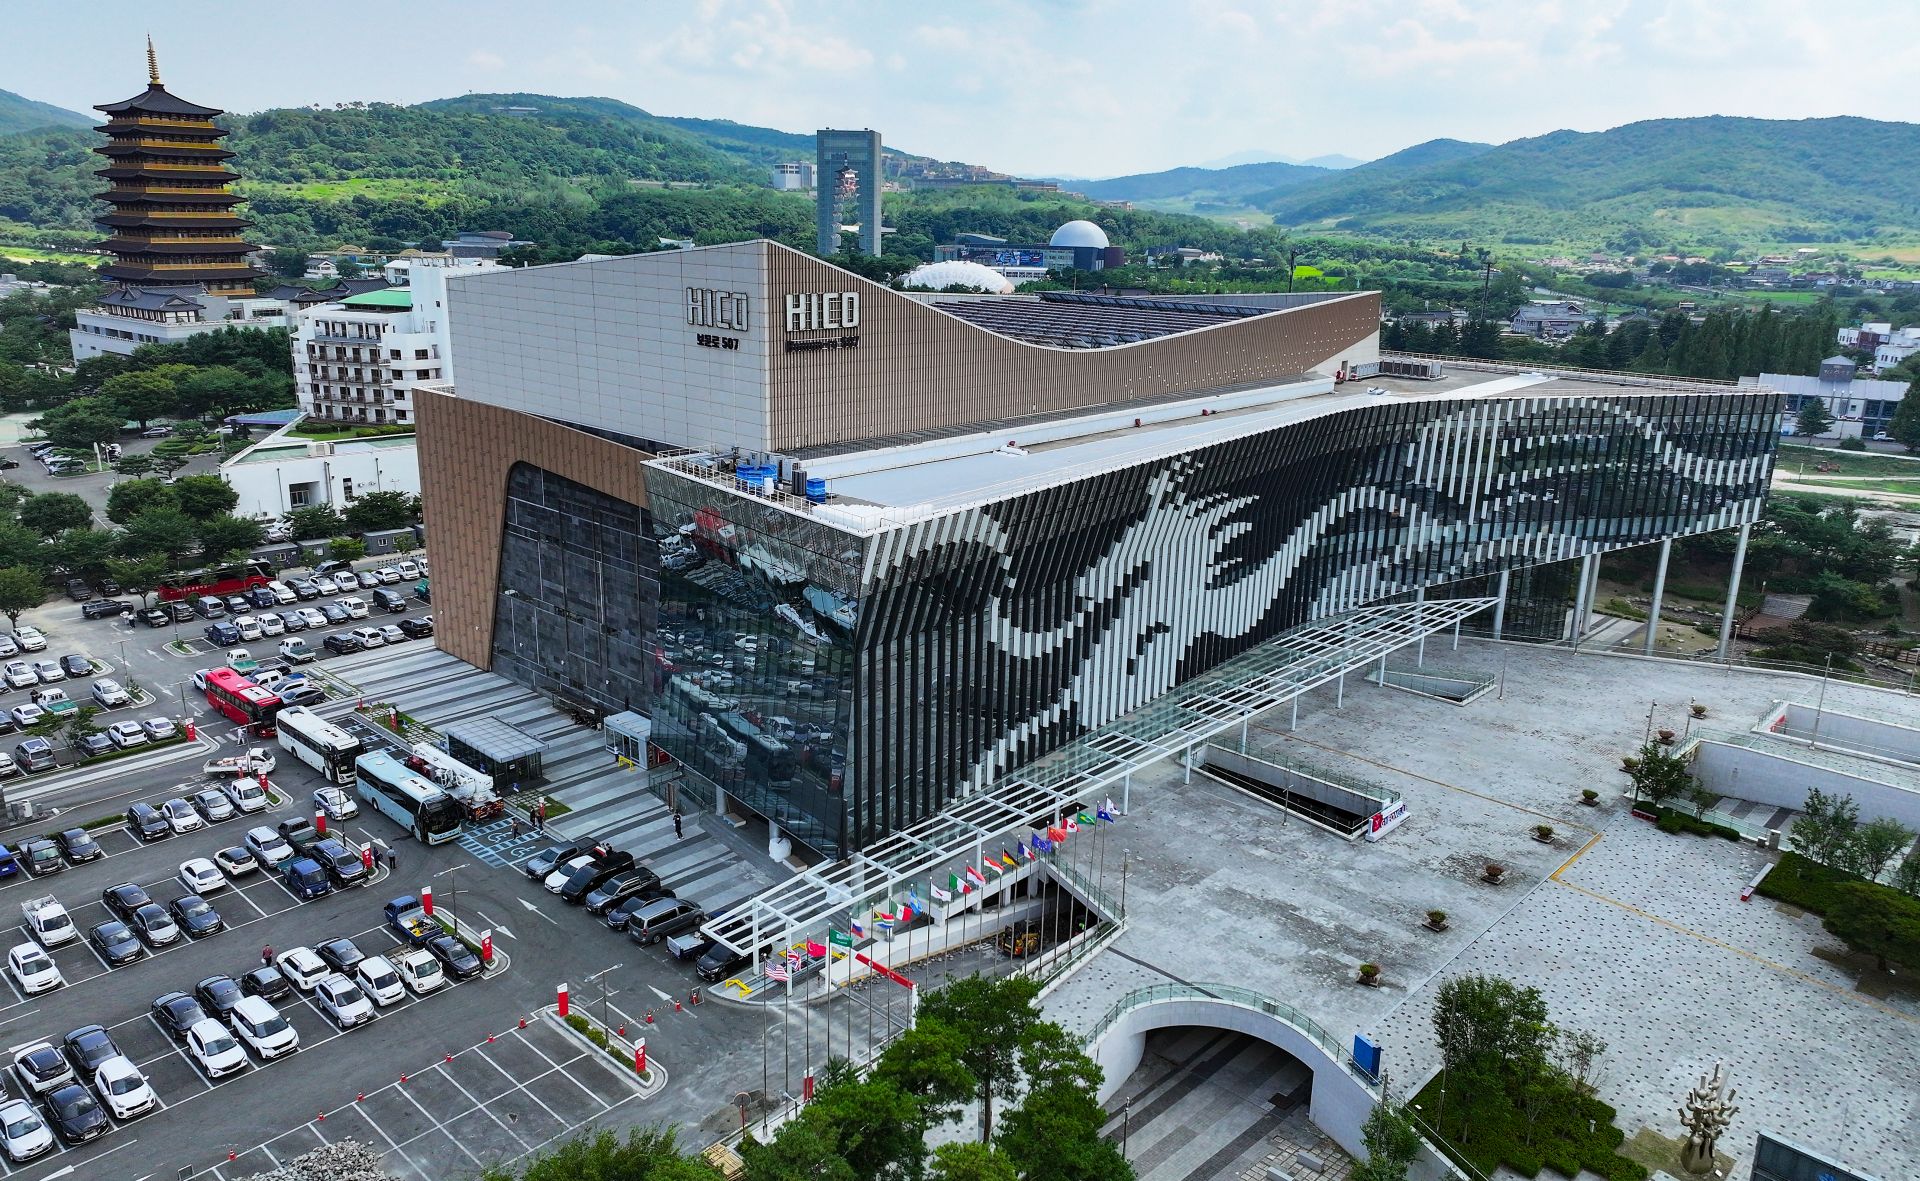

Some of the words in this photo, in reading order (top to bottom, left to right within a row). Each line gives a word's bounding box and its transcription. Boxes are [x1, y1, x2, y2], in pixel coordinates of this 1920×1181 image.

[686, 286, 749, 332] HICO
[786, 291, 860, 332] HICO
[721, 336, 740, 351] 507
